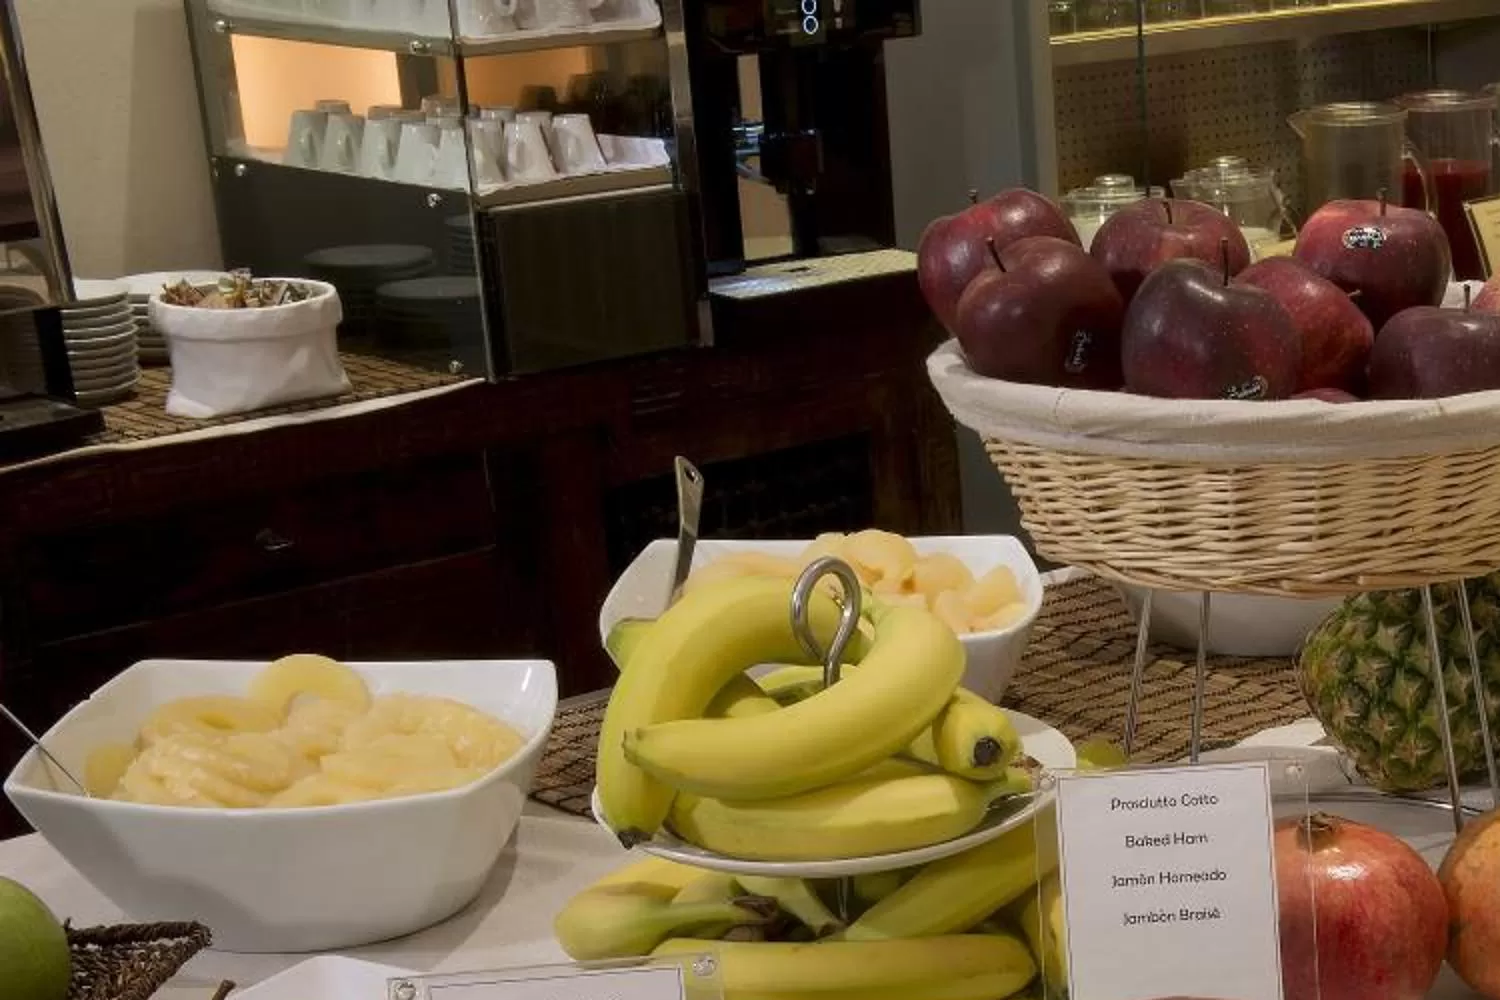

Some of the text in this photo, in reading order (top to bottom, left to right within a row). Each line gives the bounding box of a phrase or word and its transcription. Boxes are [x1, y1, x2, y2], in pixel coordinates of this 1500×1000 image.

[1111, 793, 1219, 811] Prosciutto Cotto
[1125, 831, 1209, 848] Baked Ham
